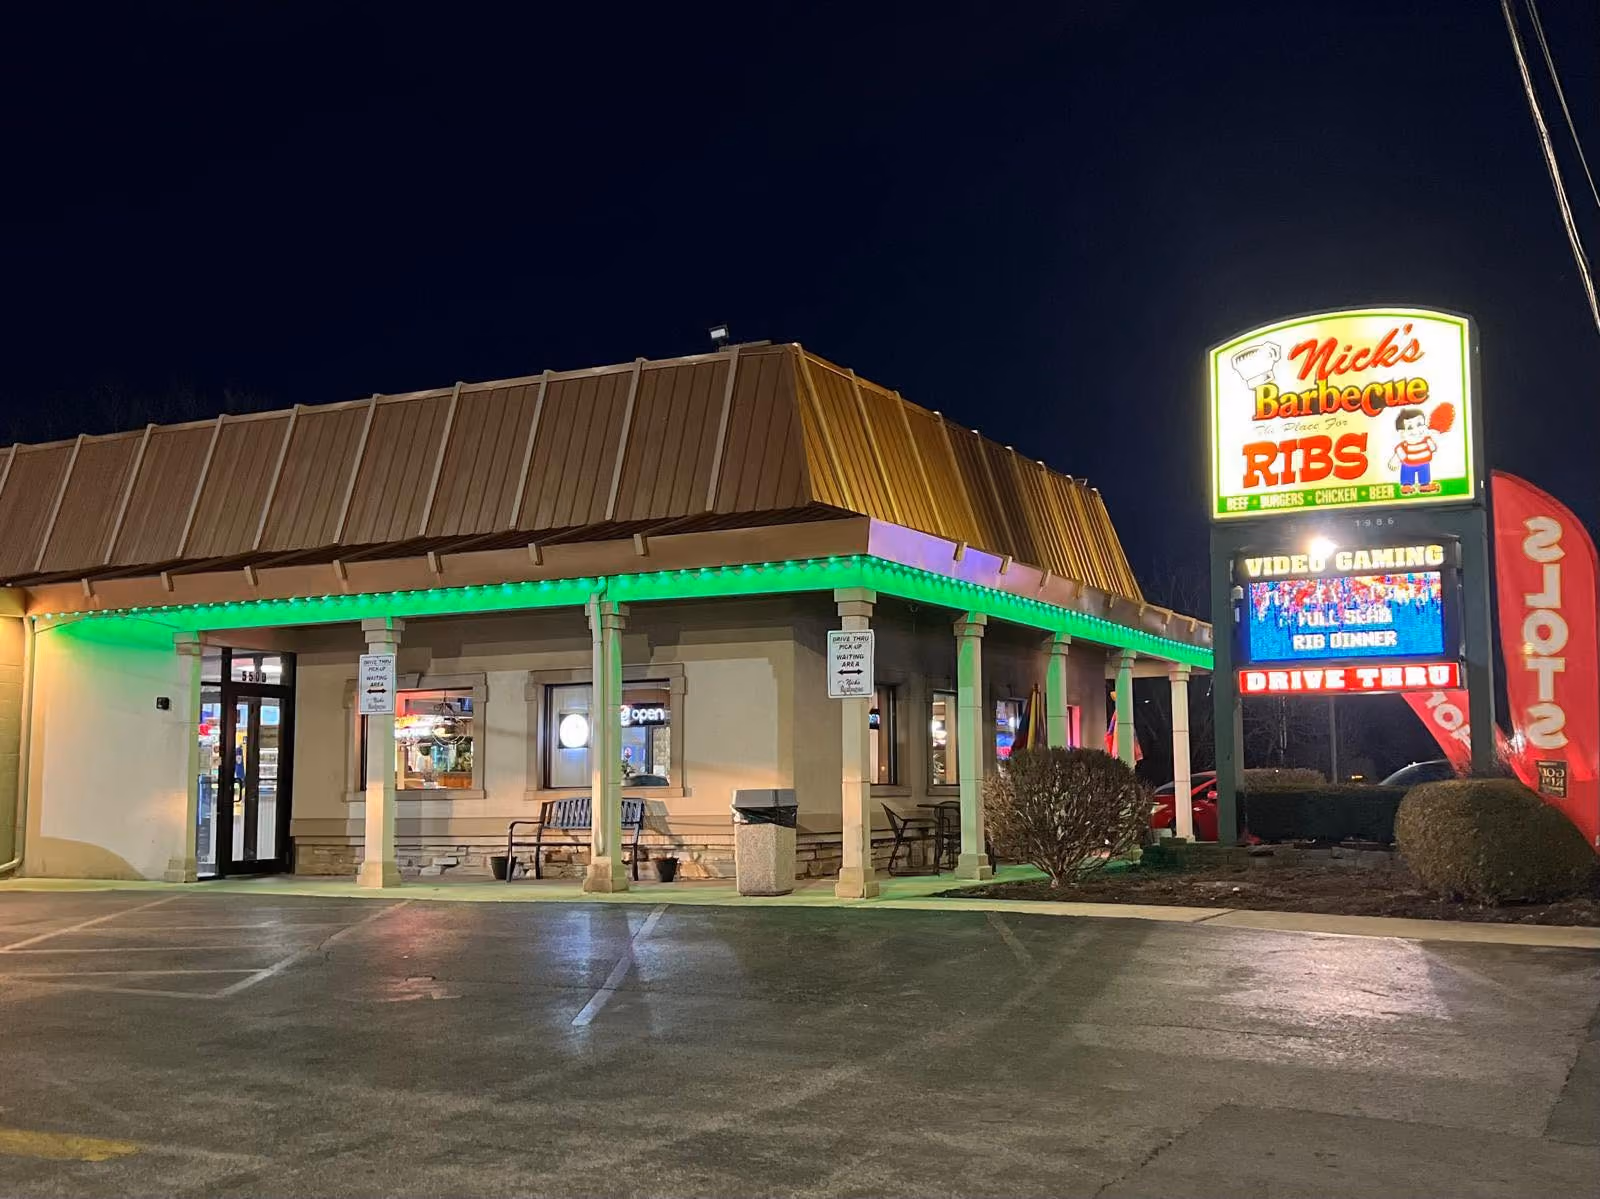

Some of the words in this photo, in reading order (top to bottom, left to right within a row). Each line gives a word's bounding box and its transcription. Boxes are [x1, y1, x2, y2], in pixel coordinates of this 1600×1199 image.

[1287, 323, 1426, 381] Nick's
[1252, 377, 1430, 421] Barbecue
[1283, 417, 1320, 432] Place
[1324, 417, 1348, 430] For
[1242, 432, 1368, 489] RIBS
[1226, 496, 1249, 511] BEEF
[1260, 492, 1304, 509] BURGERS
[1315, 487, 1358, 505] CHICKEN
[1245, 553, 1326, 577] VIDEO
[1335, 544, 1444, 571] GAMING
[1292, 633, 1325, 651] RIB
[1329, 630, 1398, 649] DINNER
[1247, 669, 1346, 691] DRIVE
[1356, 664, 1450, 688] THRU
[631, 707, 665, 724] open
